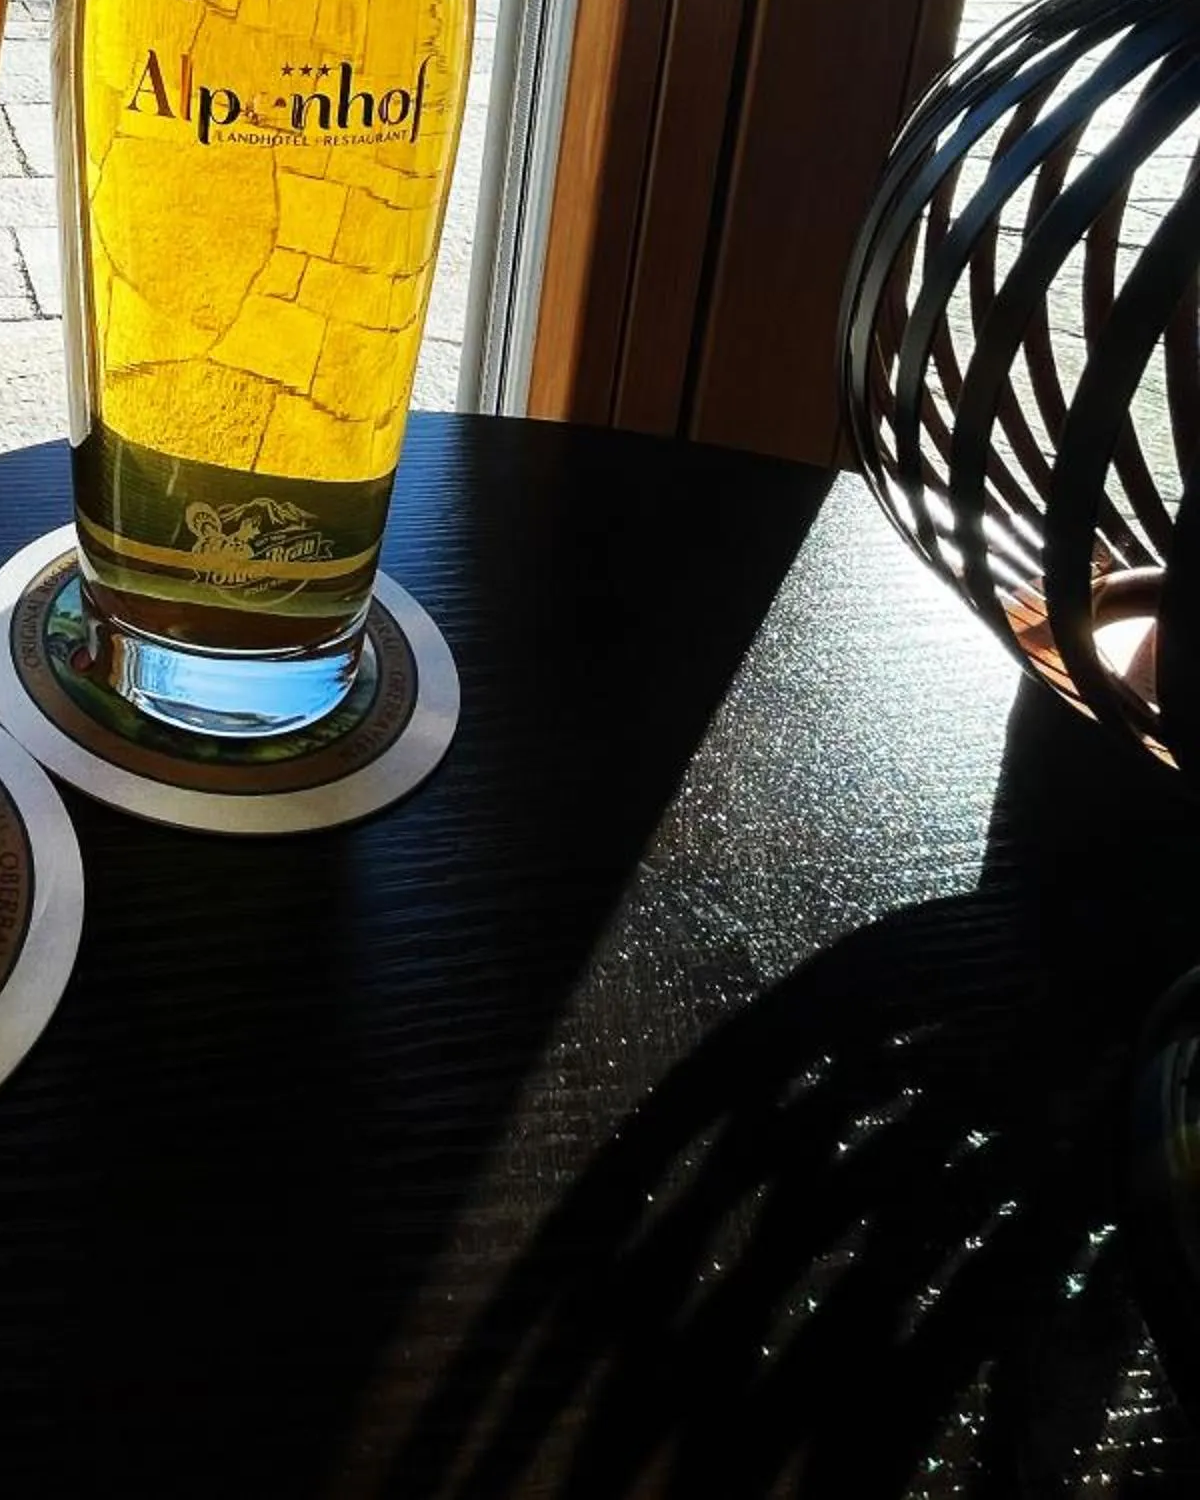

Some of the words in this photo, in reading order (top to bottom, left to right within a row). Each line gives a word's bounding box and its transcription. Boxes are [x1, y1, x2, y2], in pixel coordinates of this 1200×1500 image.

[127, 49, 438, 145] Alpnhof
[216, 129, 310, 147] LANDHOTEL
[323, 129, 409, 147] RESTAURANT
